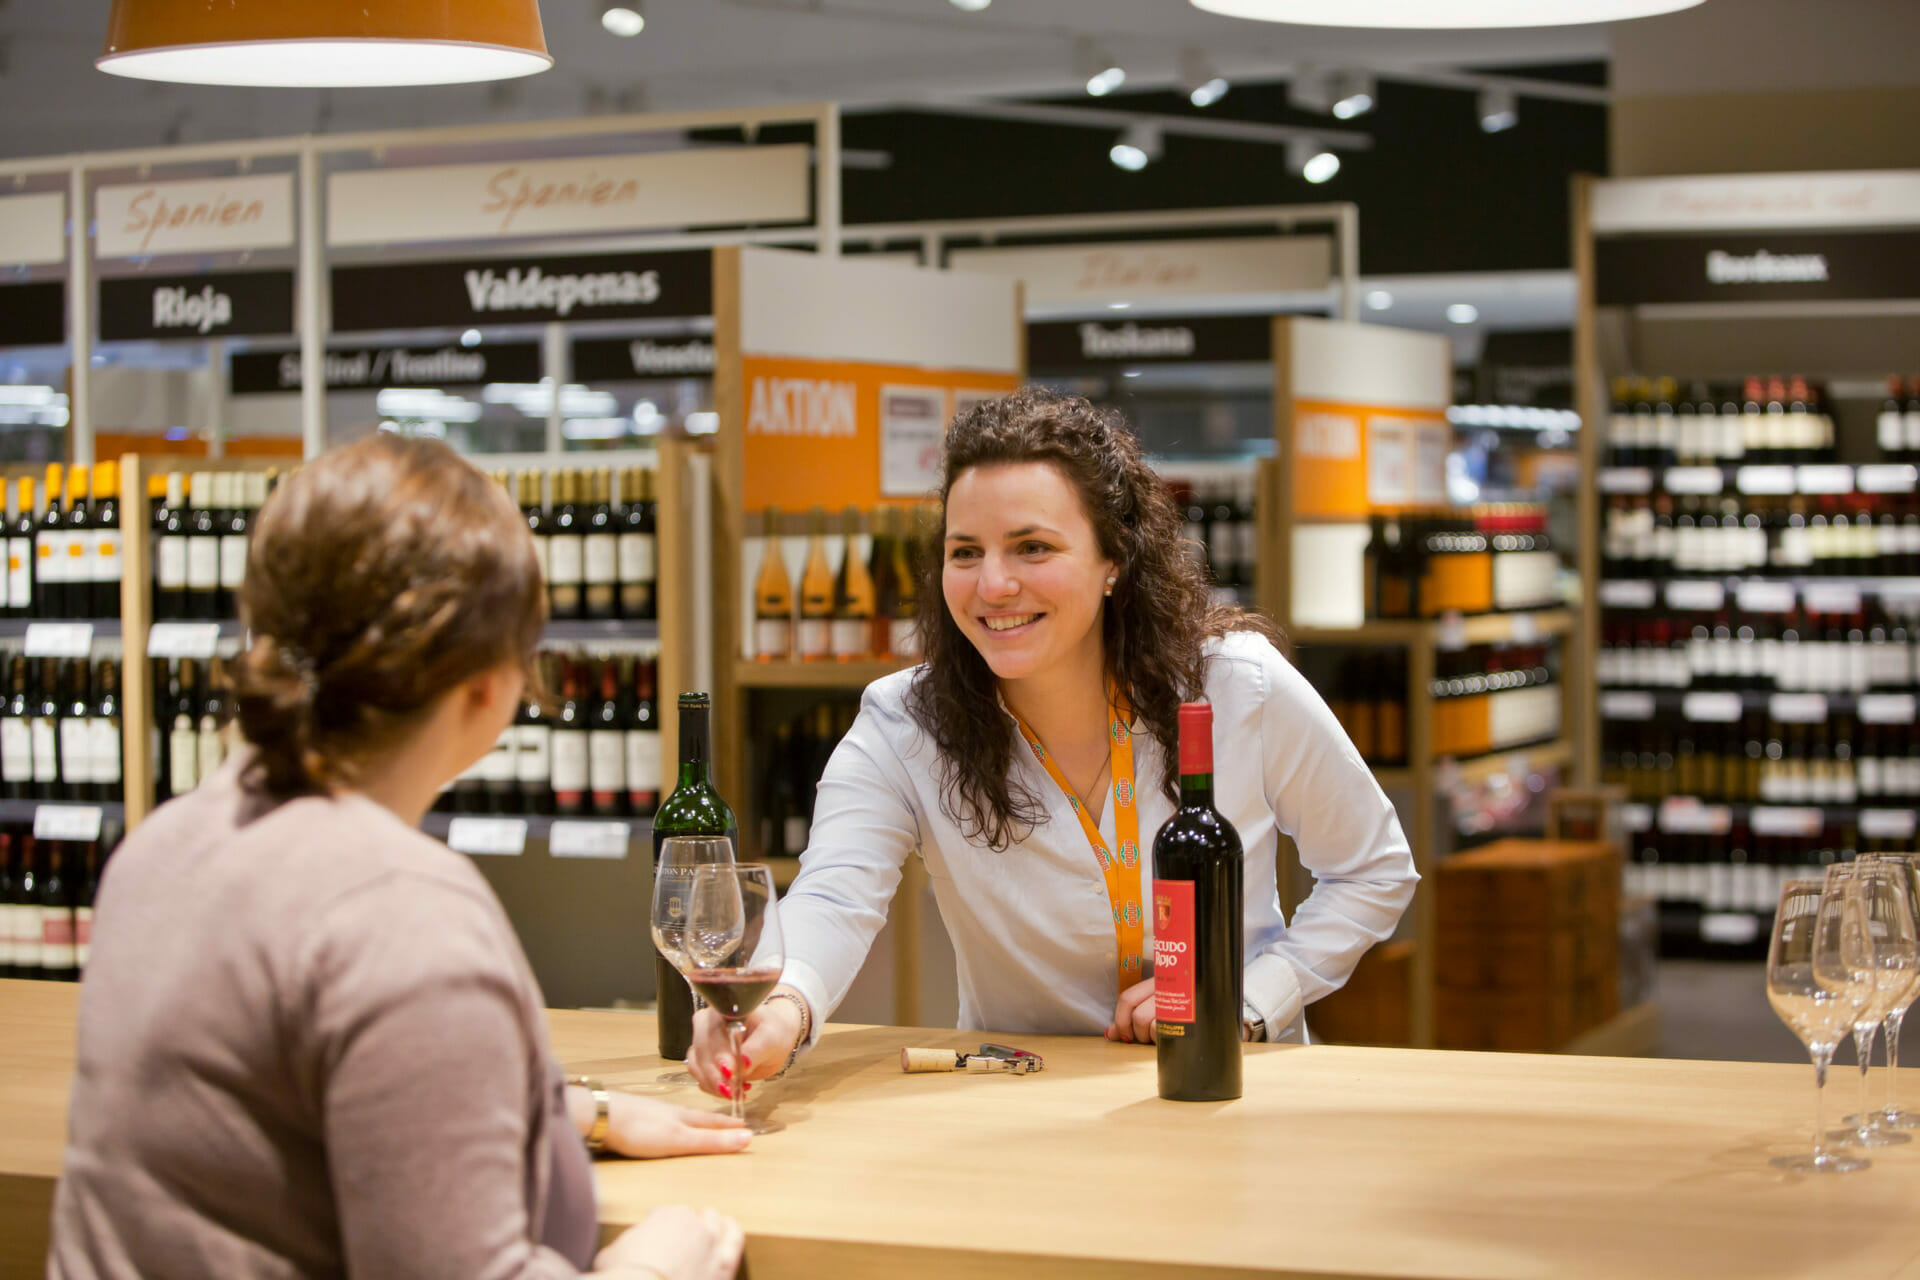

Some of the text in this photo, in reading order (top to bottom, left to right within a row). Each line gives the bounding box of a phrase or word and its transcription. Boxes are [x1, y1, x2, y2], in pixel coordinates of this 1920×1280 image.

[122, 187, 265, 252] Spanien
[152, 285, 232, 332] Rioja
[1080, 322, 1194, 356] Toskana
[749, 376, 858, 438] AKTION
[1123, 839, 1135, 869] globus
